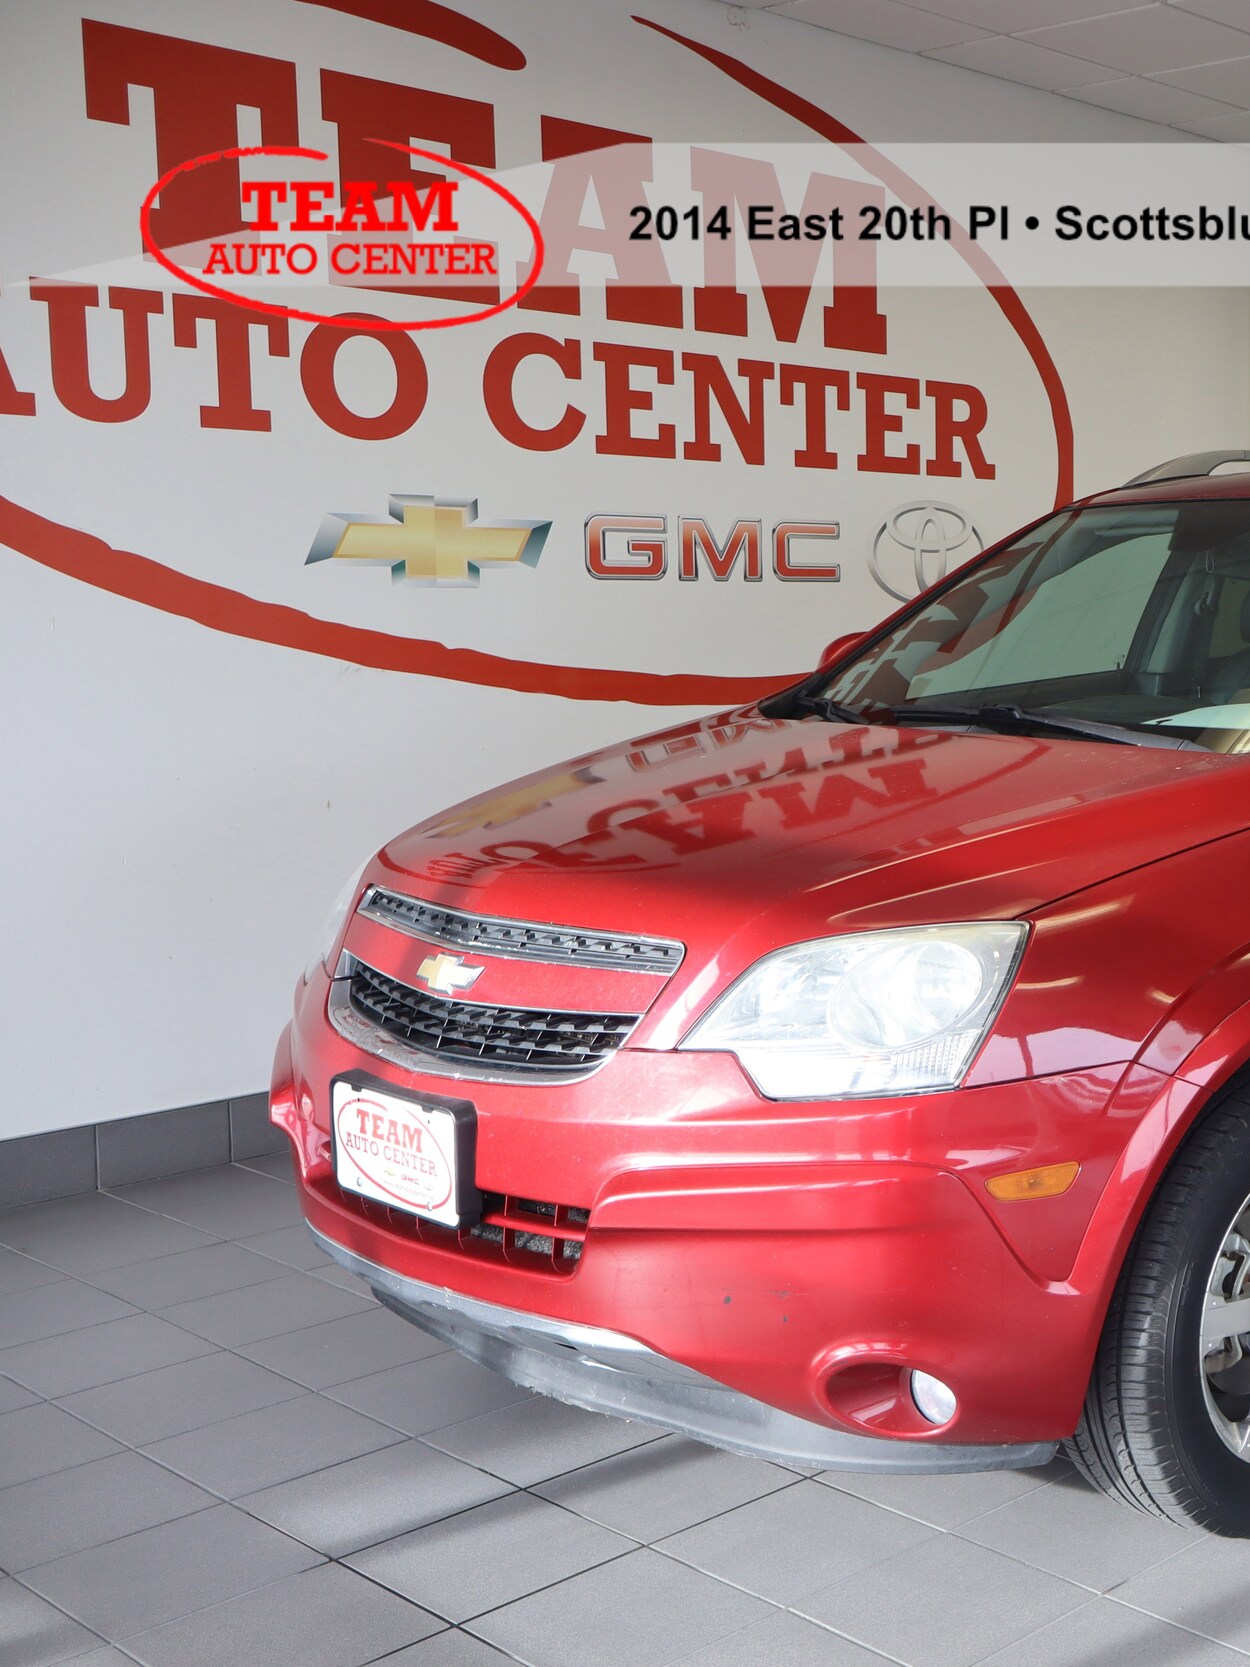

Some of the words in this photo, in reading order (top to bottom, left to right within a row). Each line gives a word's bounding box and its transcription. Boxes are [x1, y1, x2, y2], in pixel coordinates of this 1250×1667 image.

[81, 17, 887, 355] TEAM
[0, 276, 429, 441] UTO
[483, 332, 996, 480] CENTER
[584, 511, 841, 582] GMC
[346, 1131, 379, 1157] AUTO
[383, 1145, 438, 1177] CENTER
[356, 1108, 423, 1154] TEAM
